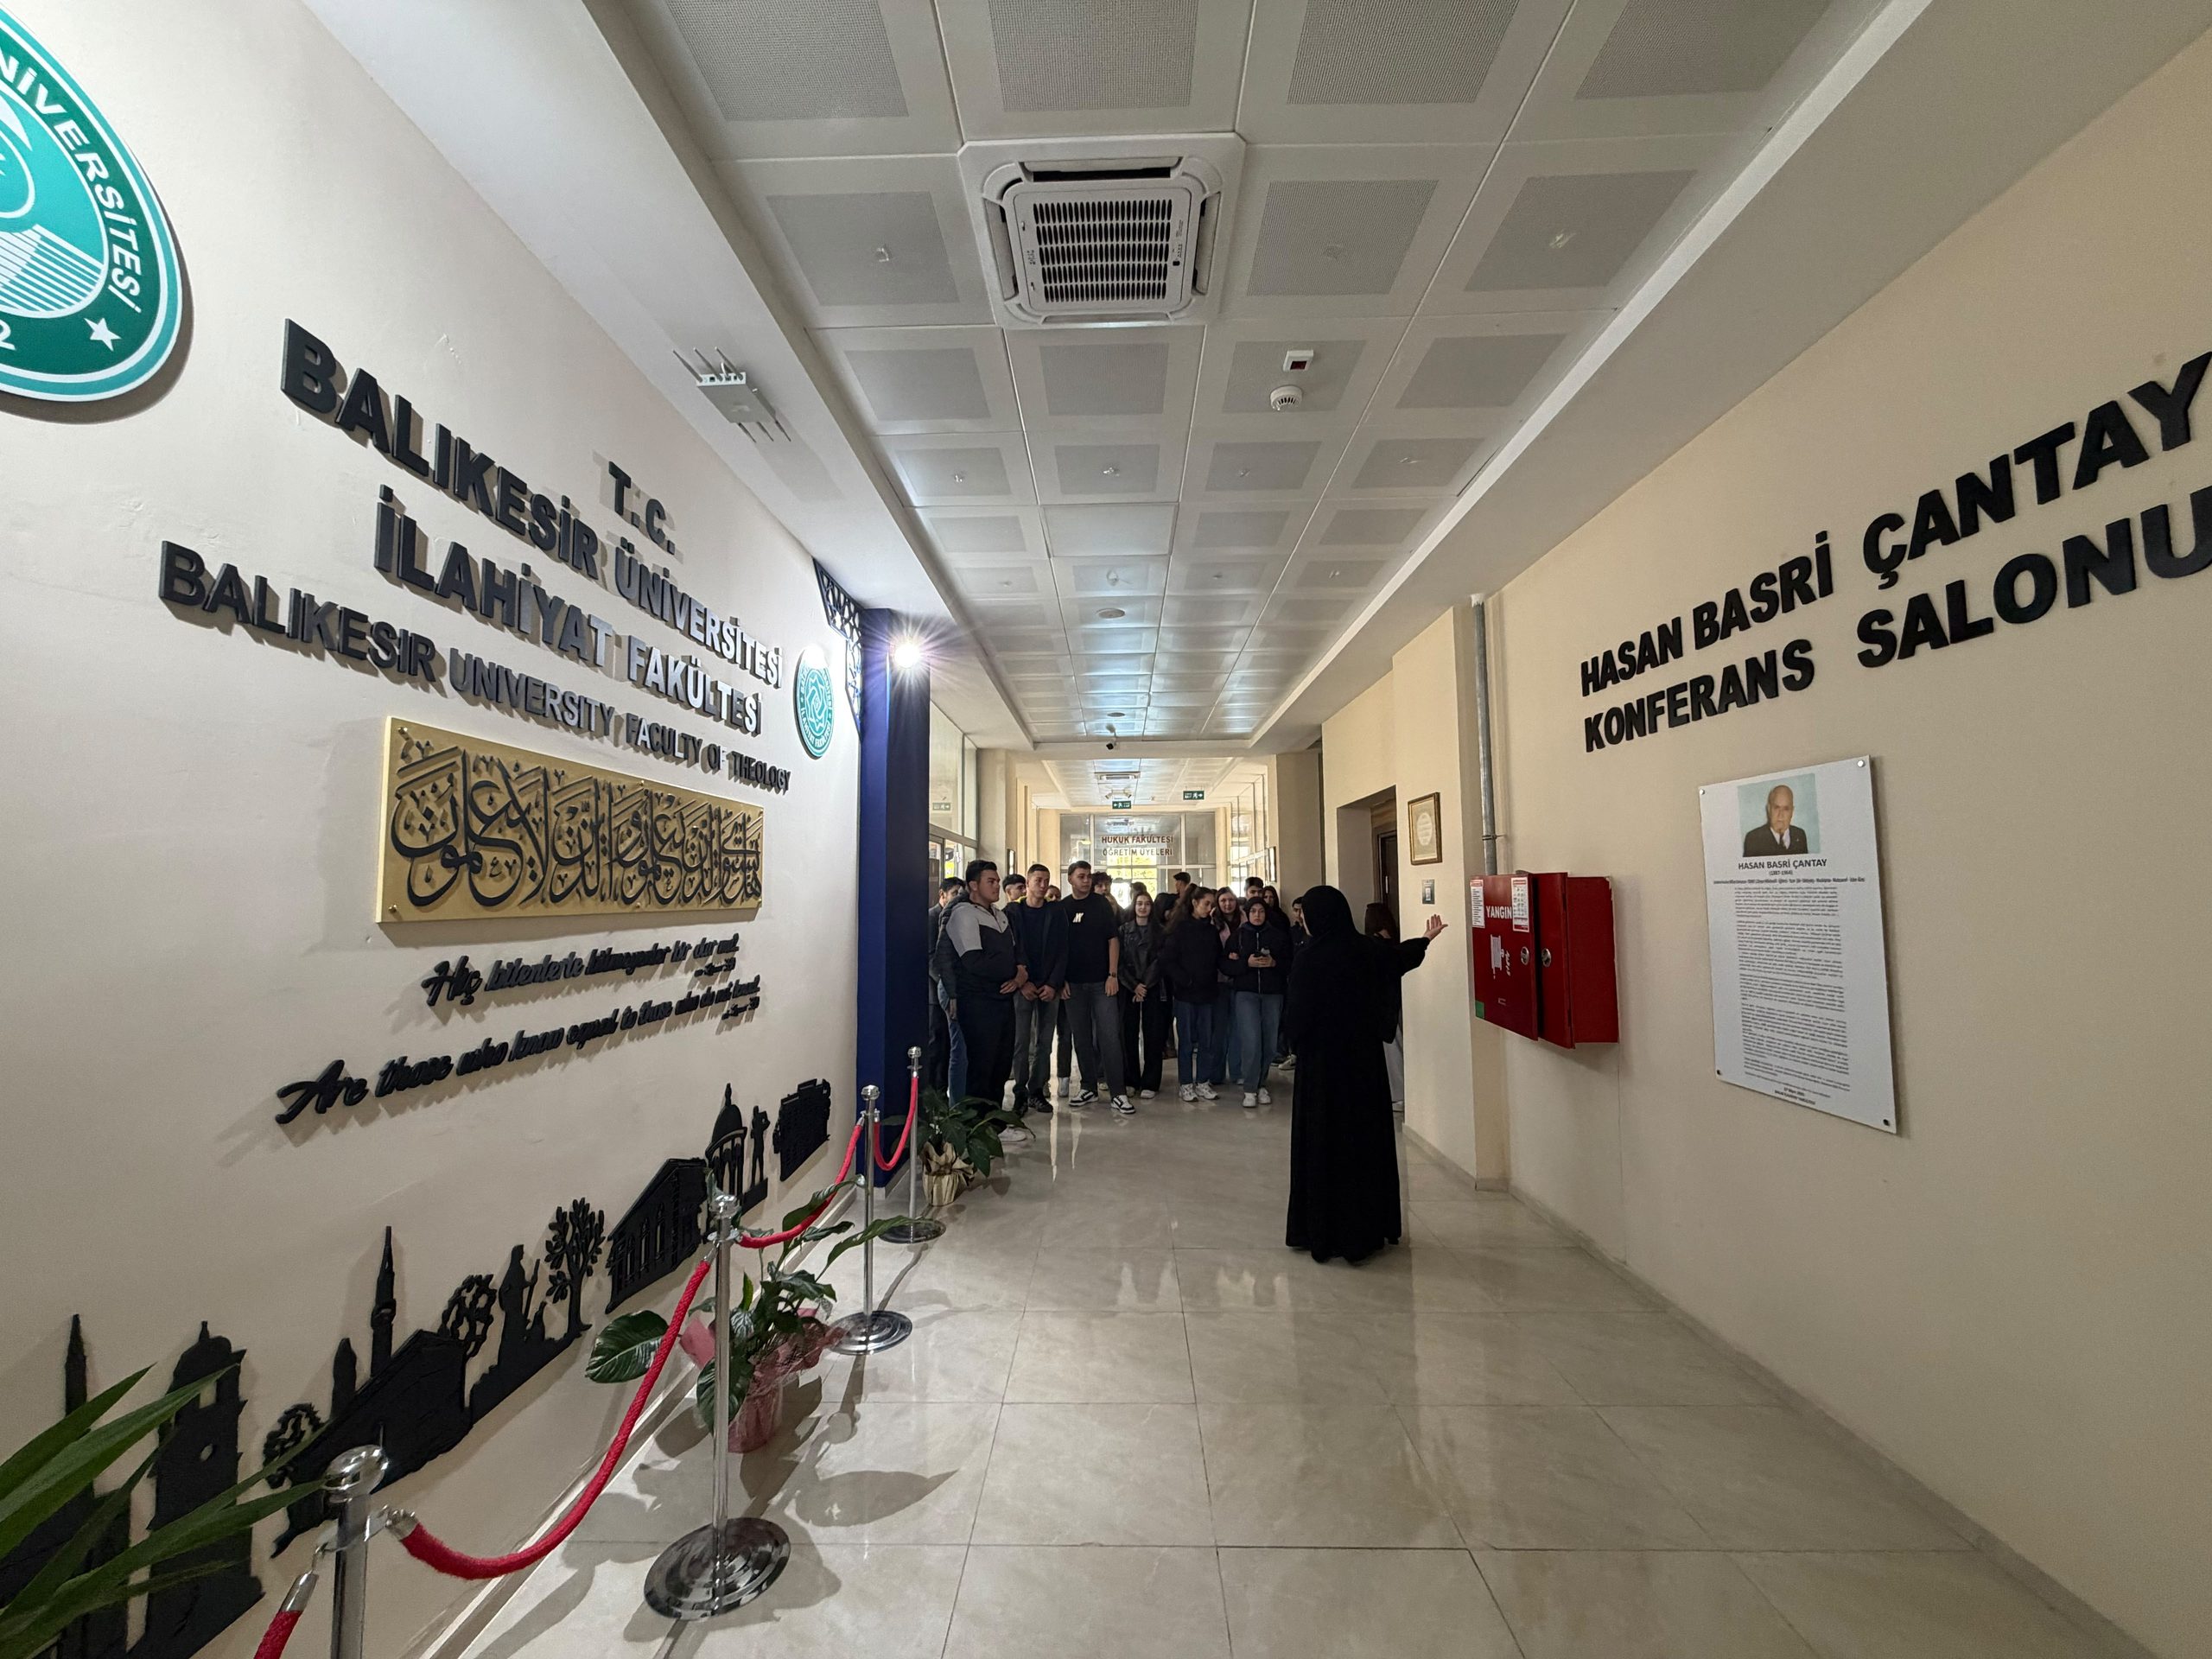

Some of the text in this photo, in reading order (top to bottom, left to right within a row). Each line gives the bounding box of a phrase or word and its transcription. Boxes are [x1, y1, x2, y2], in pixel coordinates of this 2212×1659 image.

[282, 318, 782, 689] BALIKESİR ÜNİVERSİTESİ
[608, 461, 675, 555] T.C.
[1581, 352, 2212, 697] HASAN BASRİ ÇANTAY
[159, 540, 791, 791] BALIKESIR UNIVERSITY FACULTY OF THEOLOGY
[374, 484, 762, 736] İLAHİYAT FAKÜLTESİ
[1585, 485, 2212, 753] KONFERANS SALONU
[1101, 836, 1129, 844] HUKUK
[1738, 859, 1827, 870] HASAN BASRİ ÇANTAY
[1486, 906, 1512, 919] YANGIN
[421, 956, 483, 1007] Hiç
[275, 1059, 370, 1124] Are
[374, 1055, 454, 1097] those
[455, 1037, 509, 1077] who
[507, 1029, 564, 1062] know
[567, 1008, 620, 1050] equal
[620, 1006, 638, 1030] to
[638, 1000, 673, 1026] those
